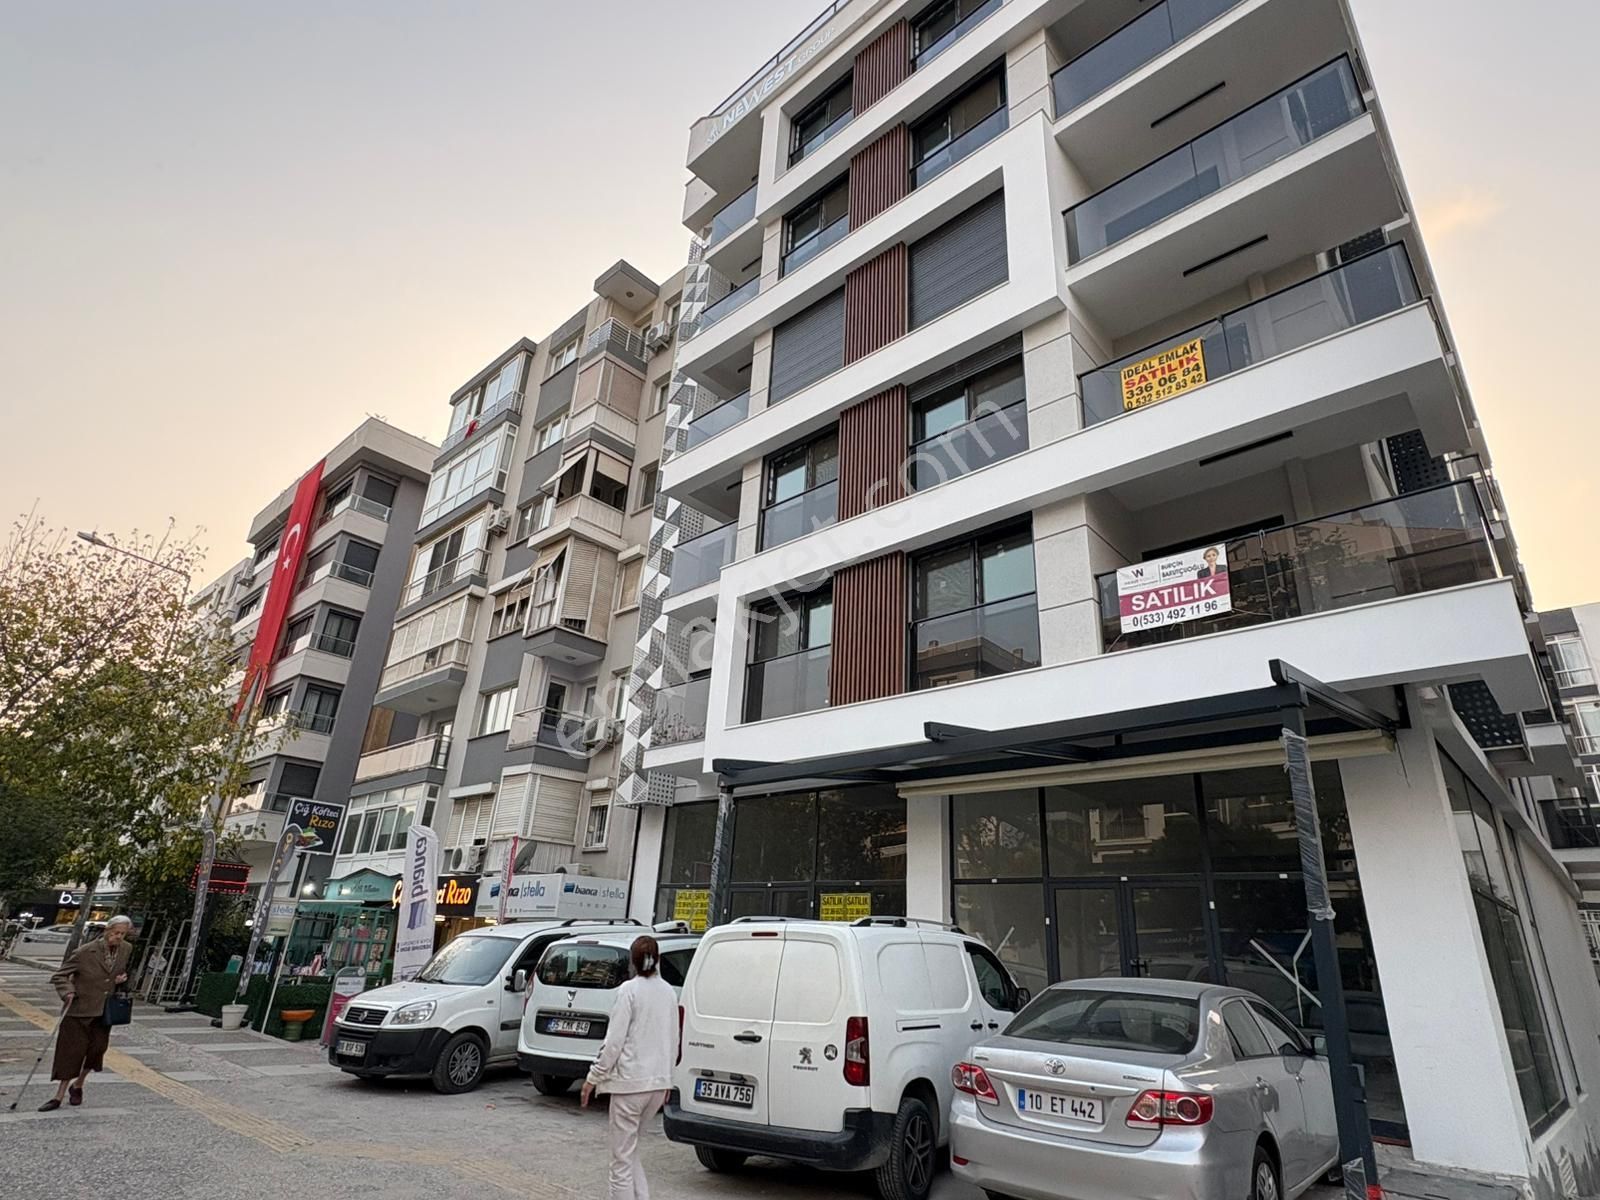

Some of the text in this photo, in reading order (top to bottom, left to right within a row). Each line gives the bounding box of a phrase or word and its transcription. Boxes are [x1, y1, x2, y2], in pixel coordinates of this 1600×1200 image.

[1158, 341, 1198, 366] EMLAK
[1124, 352, 1200, 390] SATILIK
[1126, 362, 1201, 400] 336 06 84
[1126, 373, 1203, 410] 0 532 512 83 42
[1131, 578, 1217, 611] SATILIK
[1132, 600, 1218, 628] 0(533) 492 11 96
[575, 883, 598, 896] bianca
[701, 1082, 752, 1102] 35 AVA 756
[1028, 1093, 1095, 1119] 10 ET 442
